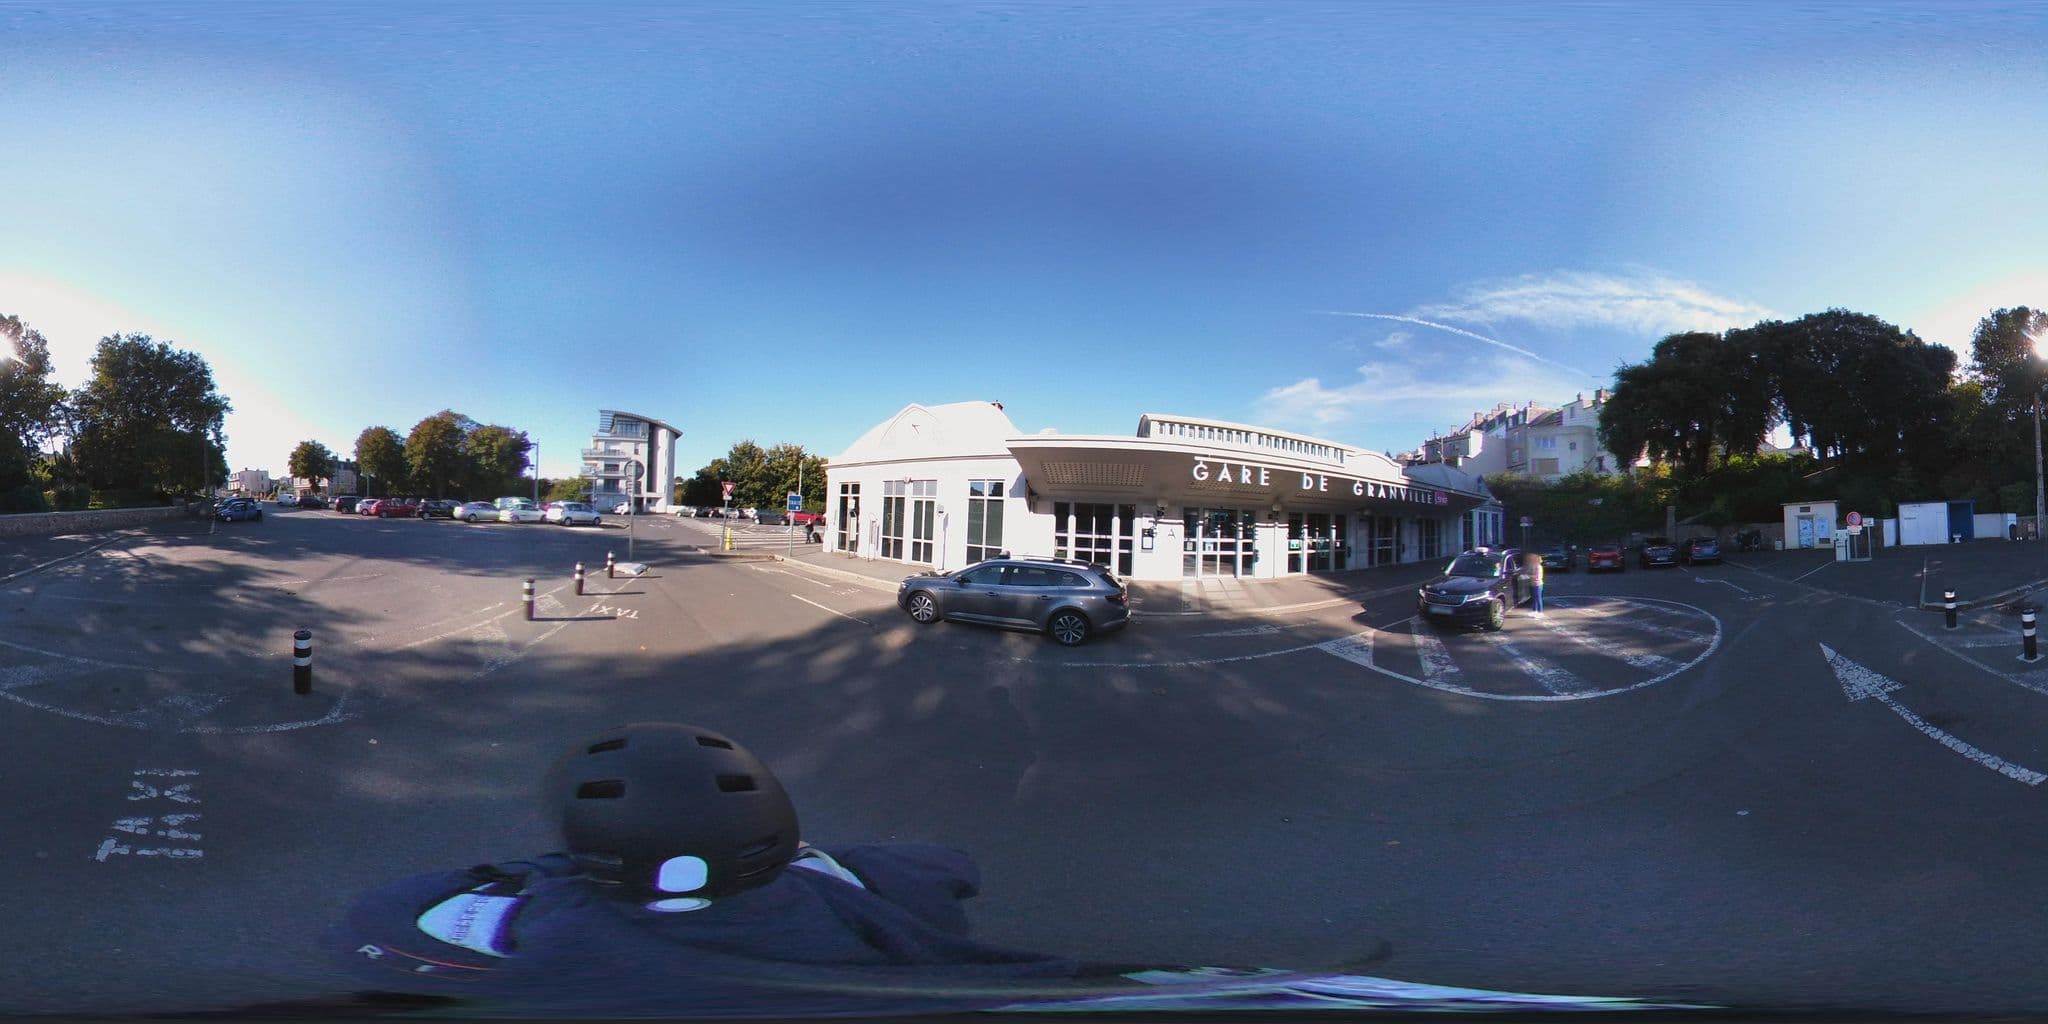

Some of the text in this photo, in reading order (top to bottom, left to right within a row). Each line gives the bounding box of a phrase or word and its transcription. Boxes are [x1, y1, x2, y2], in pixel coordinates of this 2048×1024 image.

[1193, 464, 1434, 505] GARE DE GRANVILLE
[590, 604, 640, 620] TAXI
[95, 768, 204, 863] TAXI
